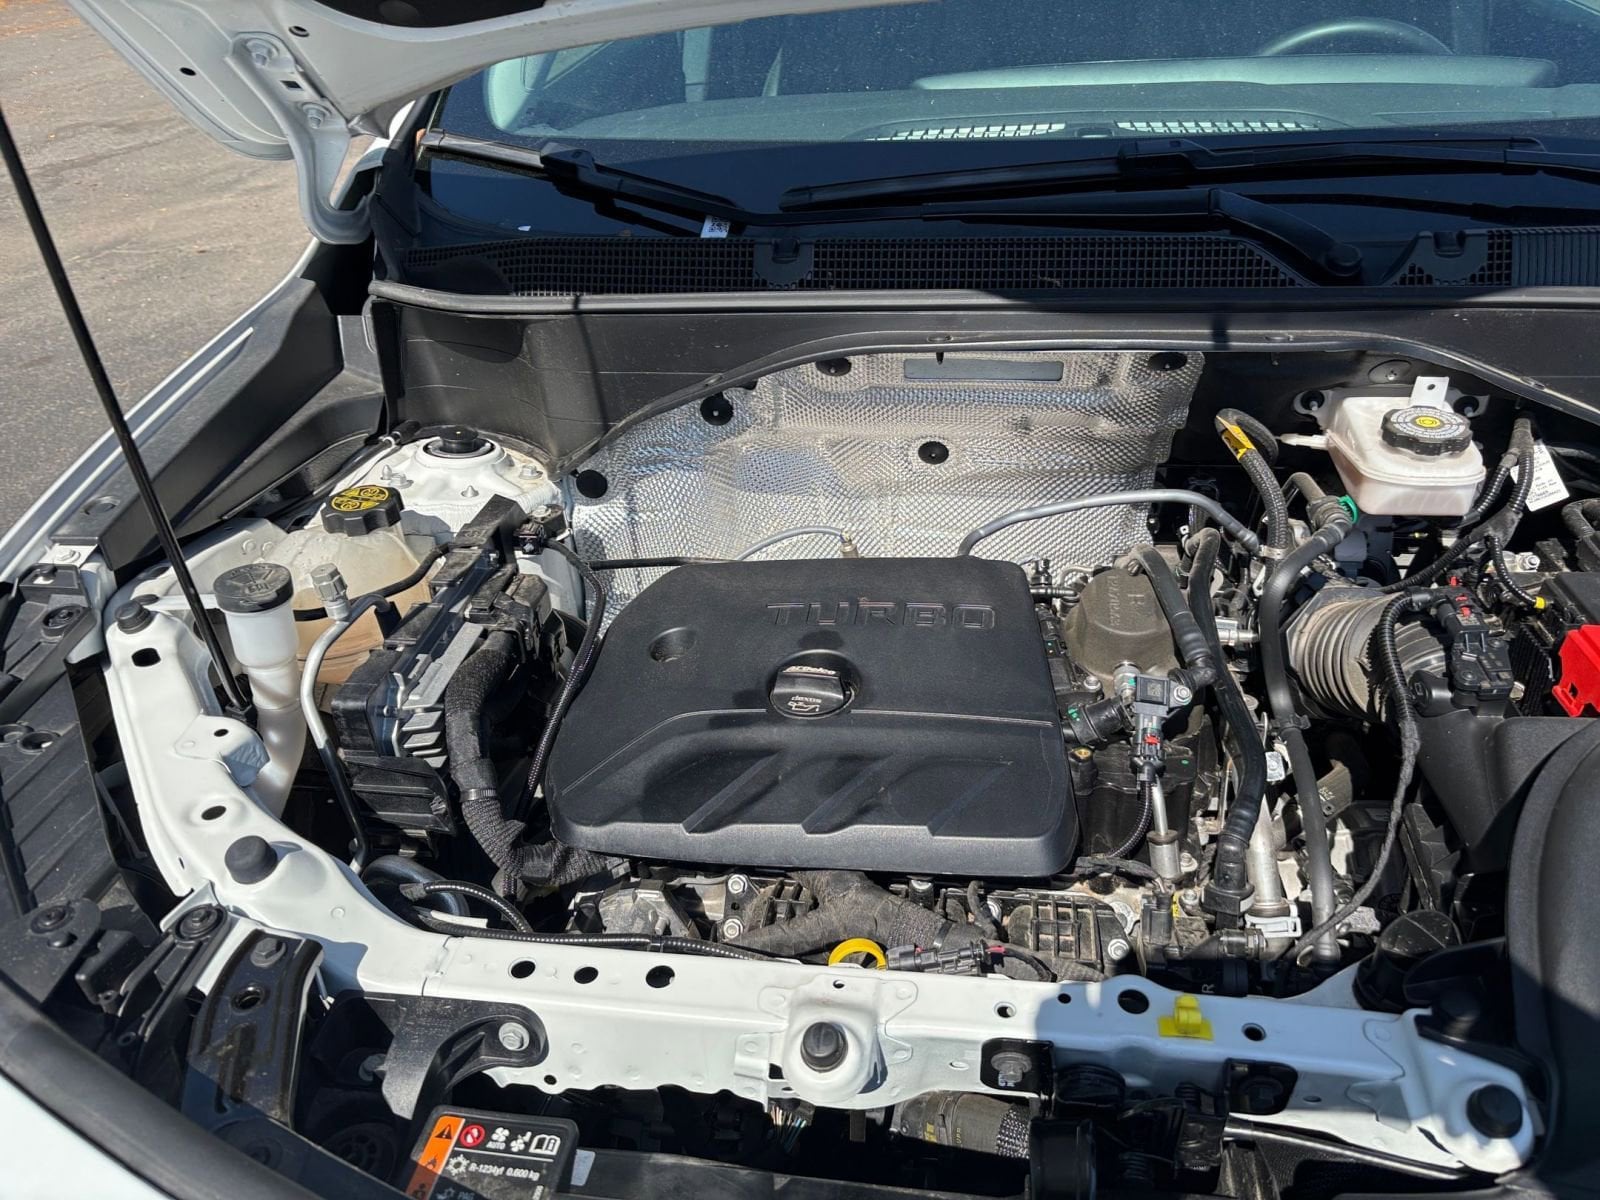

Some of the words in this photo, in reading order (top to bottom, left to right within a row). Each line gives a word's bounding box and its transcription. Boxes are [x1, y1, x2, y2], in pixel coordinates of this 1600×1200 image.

[766, 602, 996, 629] TURBO
[791, 695, 822, 704] dexos
[486, 1141, 506, 1150] AUTO
[469, 1163, 505, 1176] R-1234yf
[528, 1170, 540, 1181] kg
